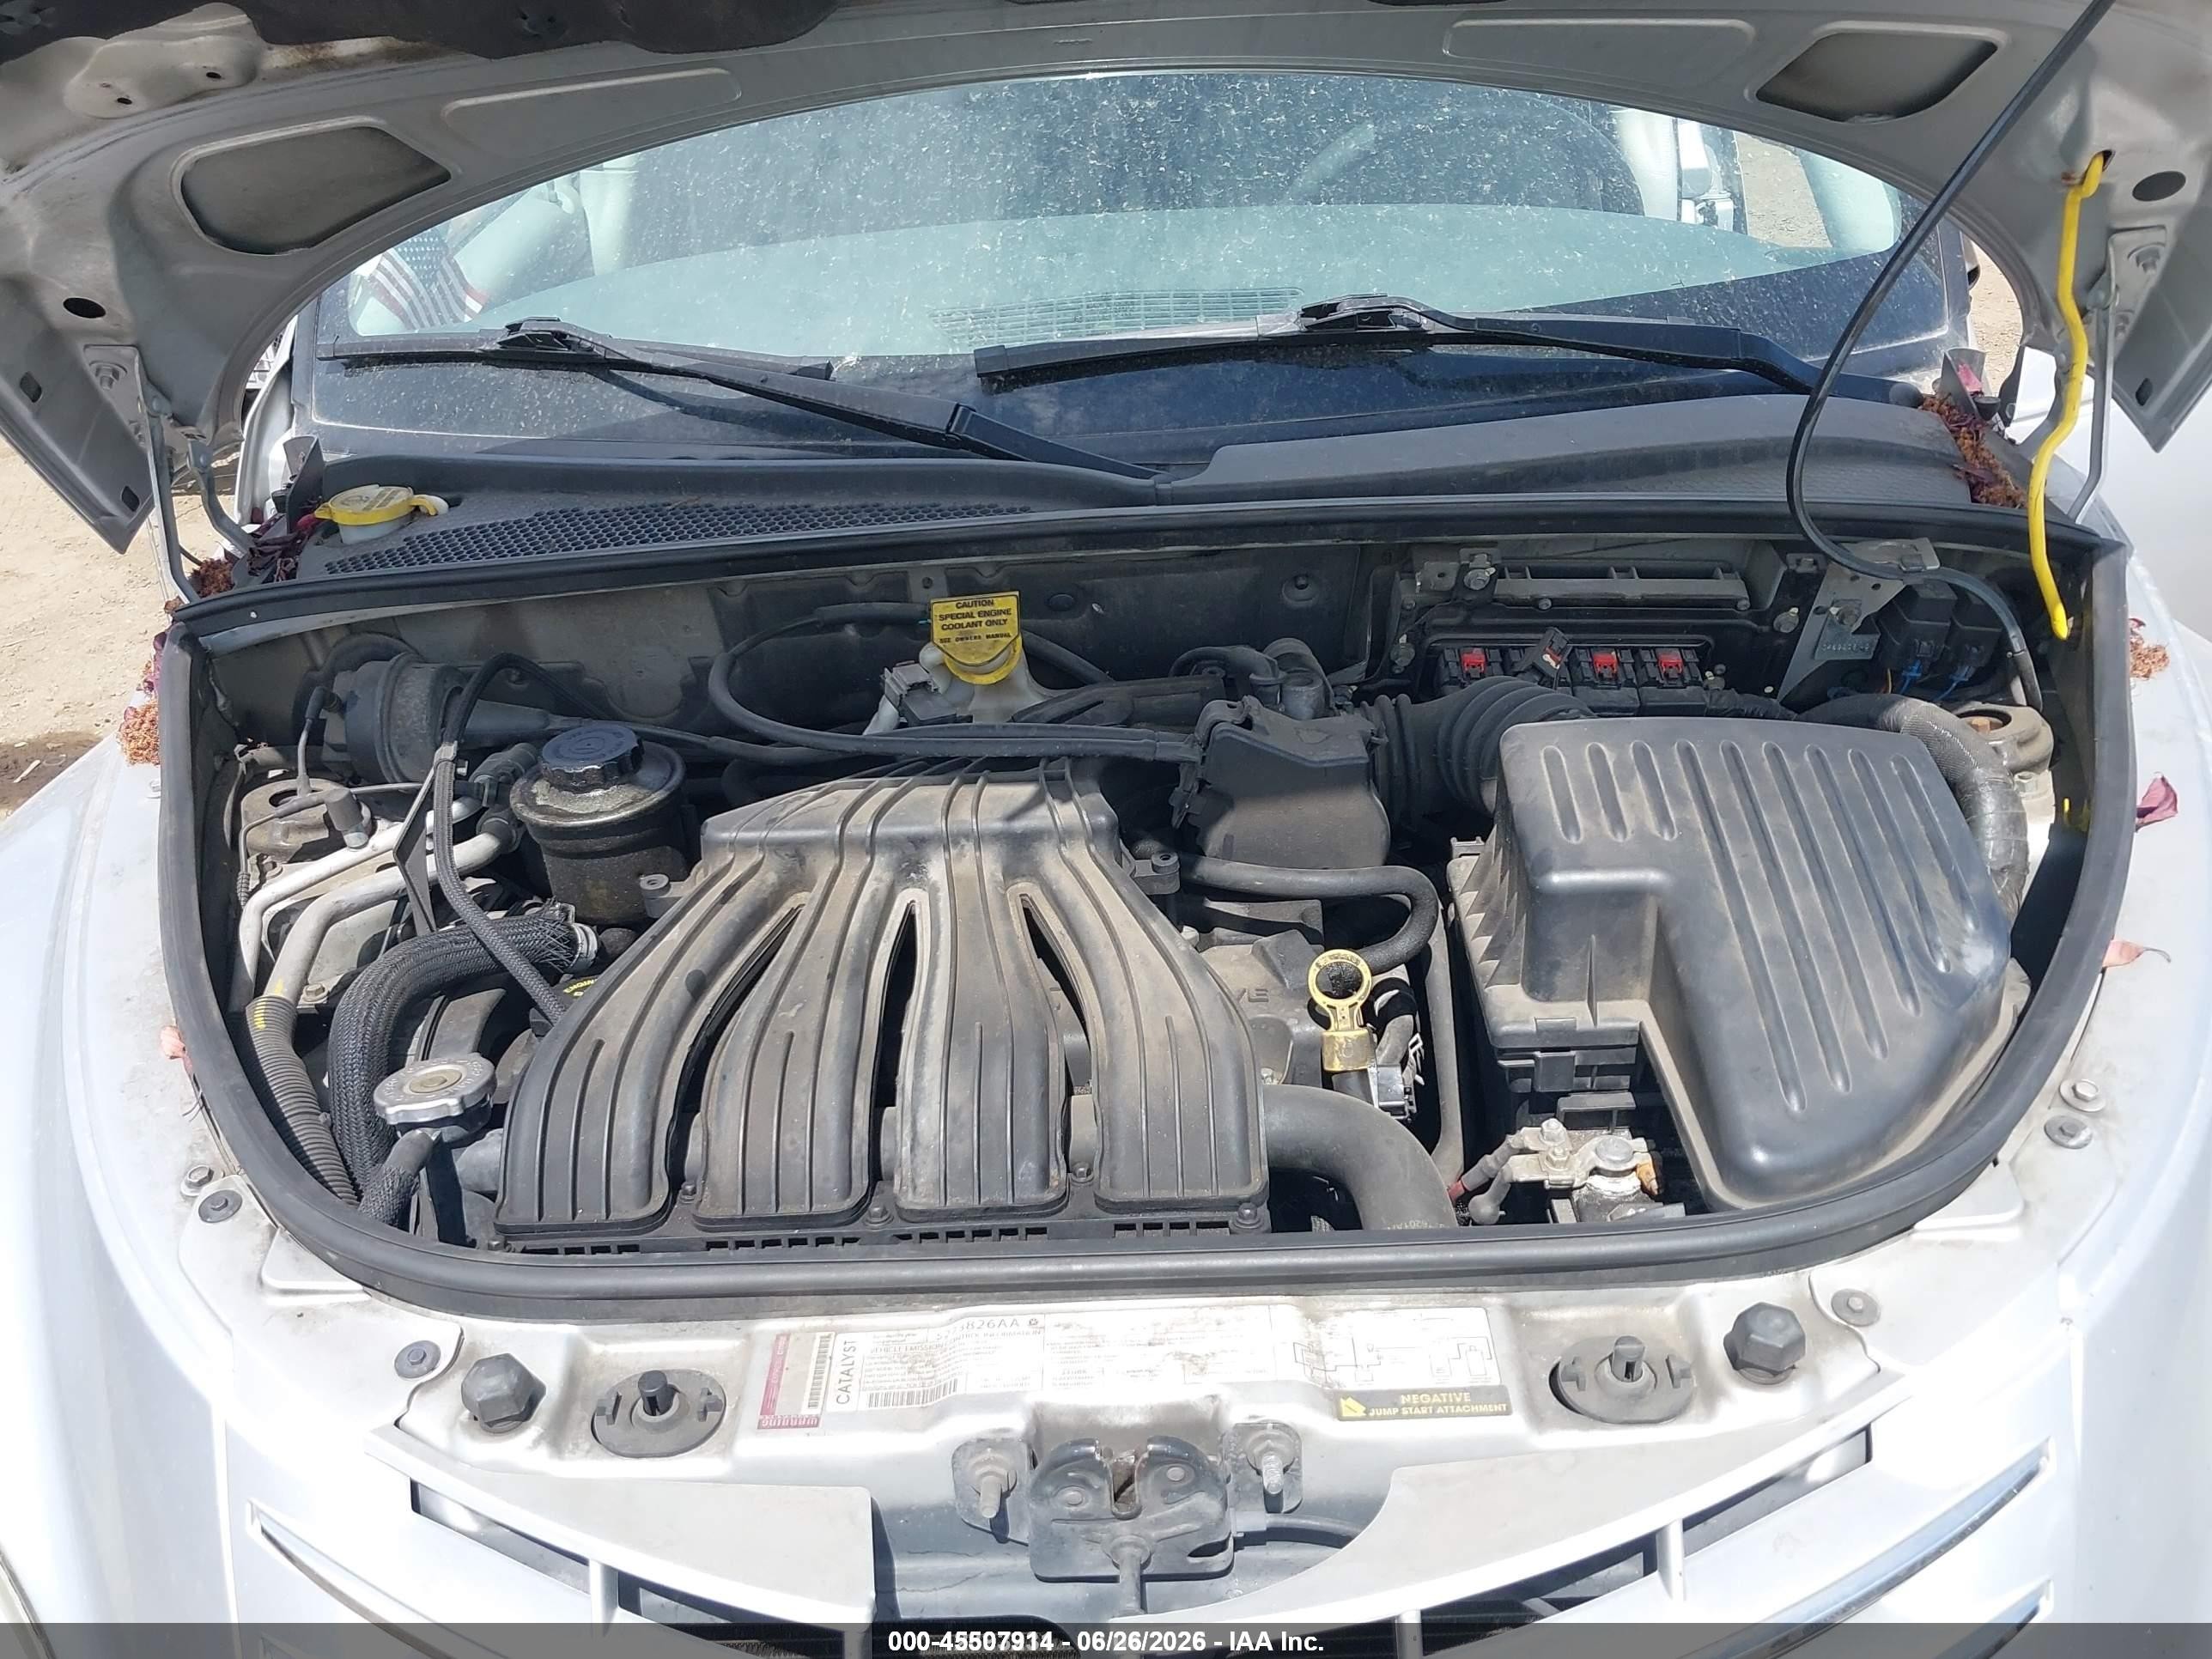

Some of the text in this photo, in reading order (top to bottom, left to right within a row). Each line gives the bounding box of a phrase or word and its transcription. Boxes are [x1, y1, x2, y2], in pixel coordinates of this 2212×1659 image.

[956, 599, 994, 609] CAUTION
[939, 608, 1012, 621] SPECIAL ENGINE
[941, 618, 1008, 630] COOLANT ONLY
[836, 1340, 859, 1405] CATALYST
[1401, 1392, 1471, 1404] NEGATIVE
[1369, 1404, 1507, 1416] JUMP START ATTACHMENT
[761, 1415, 819, 1427] WARNING
